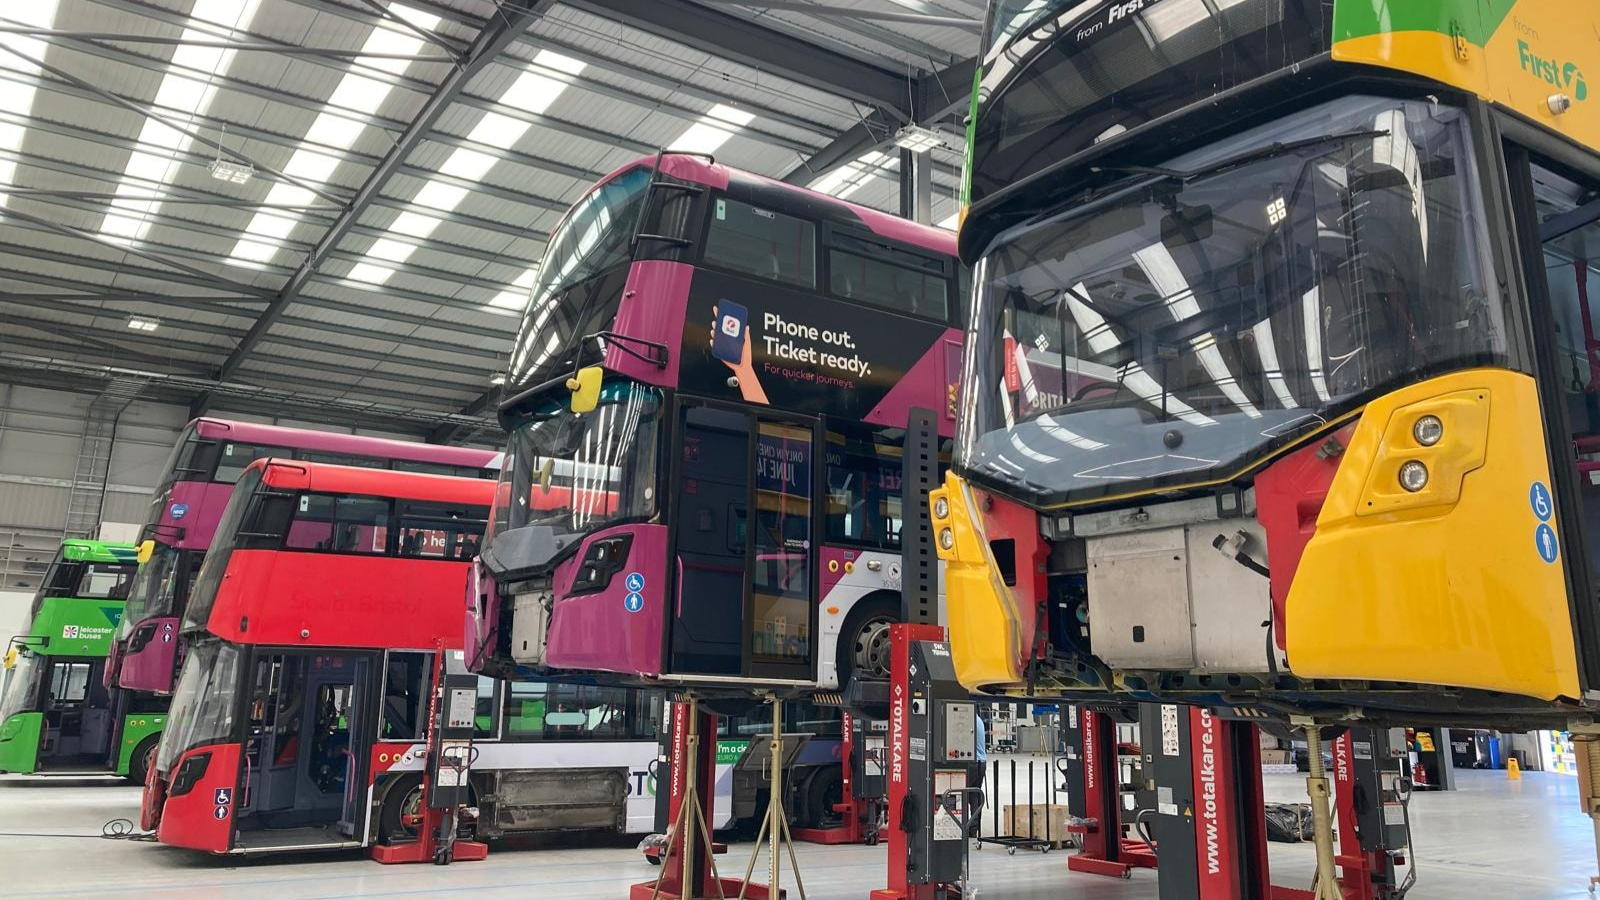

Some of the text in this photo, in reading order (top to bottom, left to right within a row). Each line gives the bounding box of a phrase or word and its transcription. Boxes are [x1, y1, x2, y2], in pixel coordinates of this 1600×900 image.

[1076, 0, 1144, 41] from First
[1513, 15, 1539, 42] from
[1517, 38, 1562, 89] First
[764, 312, 856, 350] Phone out.
[762, 335, 872, 378] Ticket ready.
[764, 362, 855, 388] For quicker journeys.
[80, 626, 113, 634] leicester
[892, 698, 903, 783] TOTALKARE
[1336, 733, 1348, 782] ALKARE
